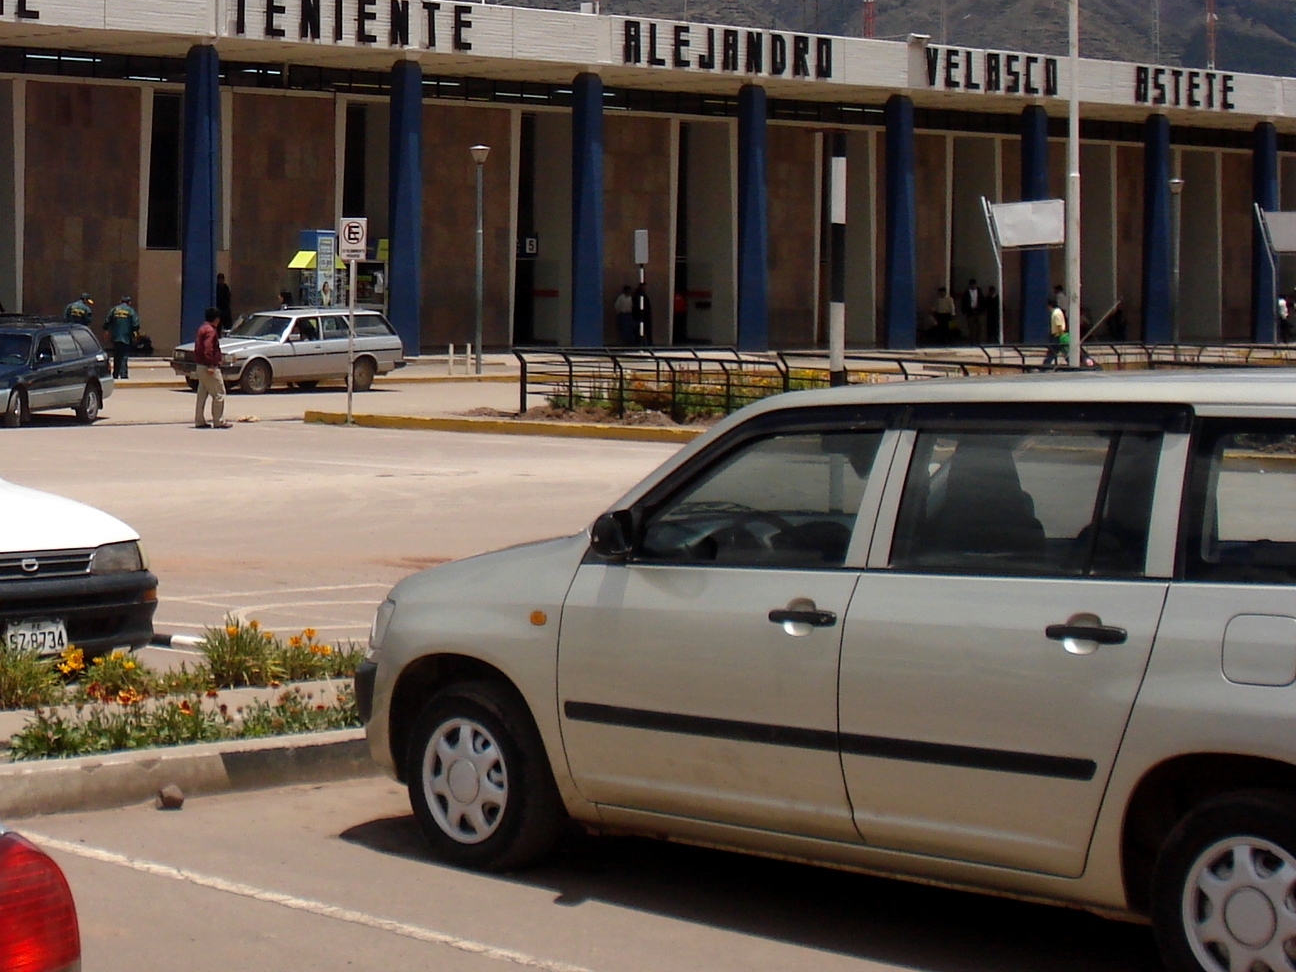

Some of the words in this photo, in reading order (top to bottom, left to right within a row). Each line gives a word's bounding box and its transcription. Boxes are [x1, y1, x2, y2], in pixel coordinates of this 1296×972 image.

[624, 20, 832, 78] ALEJANDRO
[925, 46, 1058, 96] VELASCO
[1135, 66, 1235, 110] ASTETE
[348, 225, 359, 240] E
